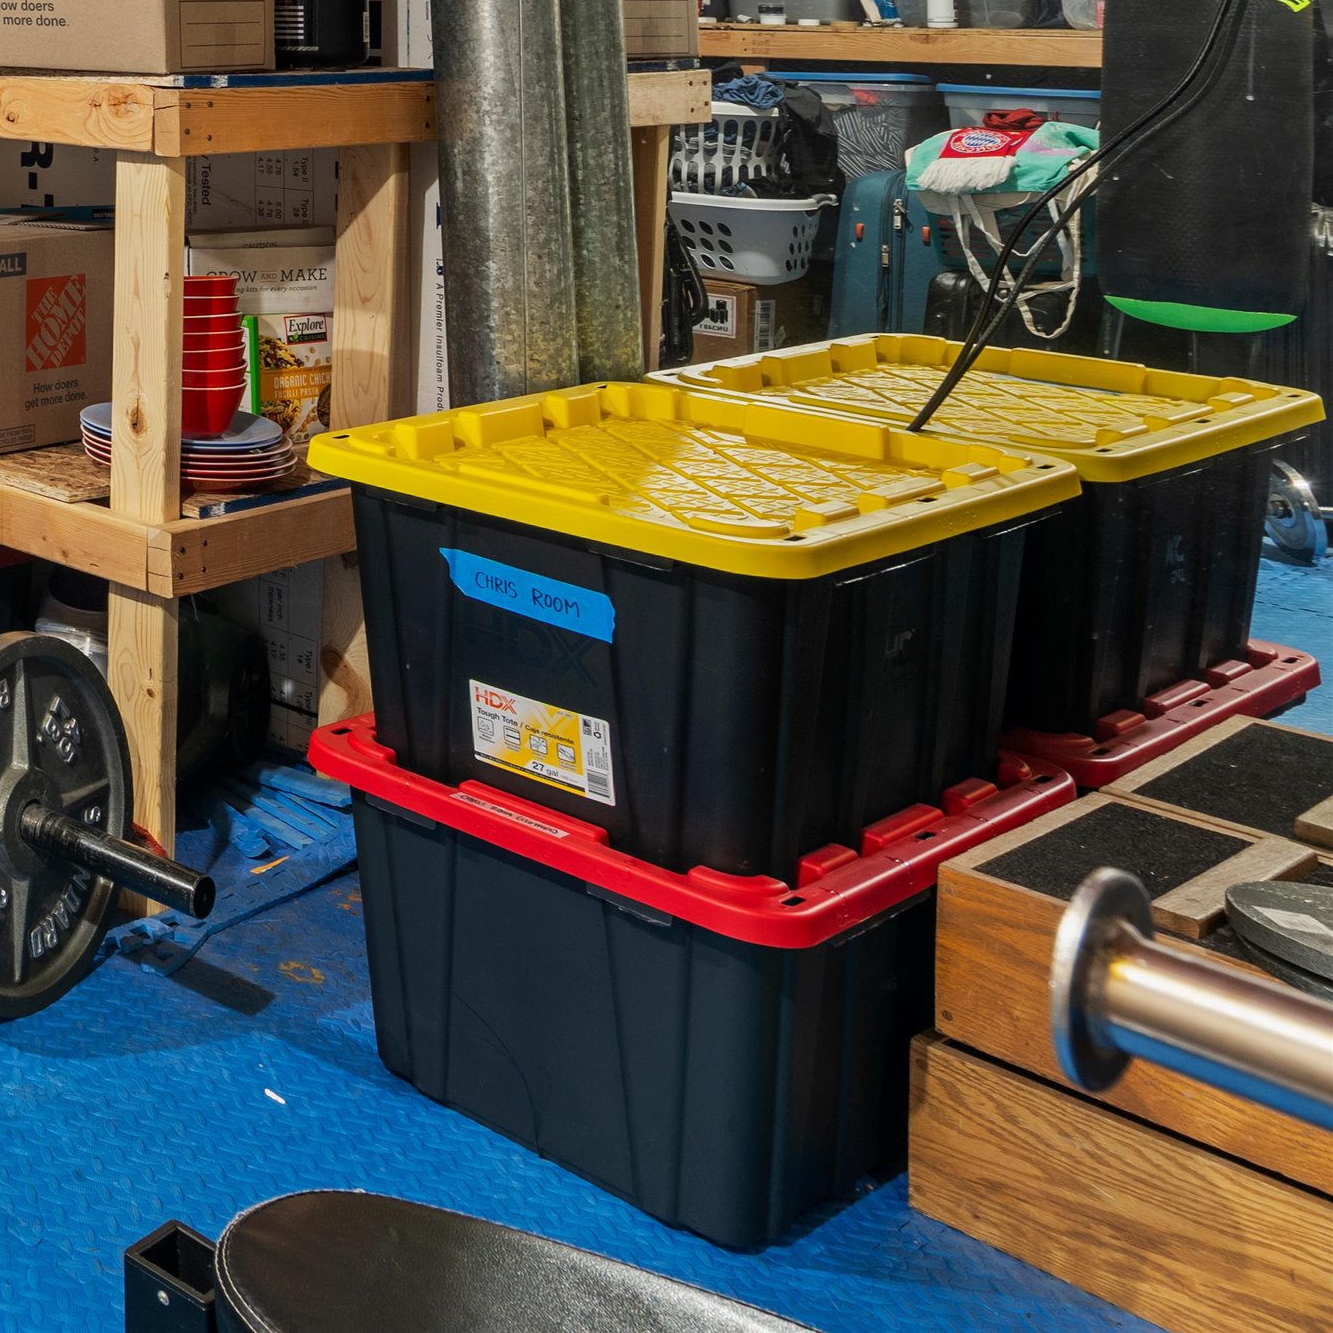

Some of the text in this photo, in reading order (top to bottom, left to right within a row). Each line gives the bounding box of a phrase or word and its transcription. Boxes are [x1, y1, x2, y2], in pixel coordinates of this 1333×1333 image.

[20, 0, 55, 12] doers
[2, 16, 34, 27] more
[259, 272, 278, 281] AND
[279, 267, 328, 282] MAKE
[244, 283, 319, 295] kits for every occasion
[26, 274, 87, 371] HOME
[287, 316, 326, 335] Explore
[49, 304, 87, 369] DEPOT
[33, 377, 80, 395] How doers
[273, 373, 309, 389] ORGANIC
[274, 386, 320, 400] FUSILLI PASTA
[24, 397, 40, 412] get
[40, 394, 64, 408] more
[474, 570, 581, 619] CHRIS ROOM
[474, 686, 517, 715] HDX
[476, 706, 576, 746] Tough Tote Caja resistente
[531, 760, 560, 780] 27 gal
